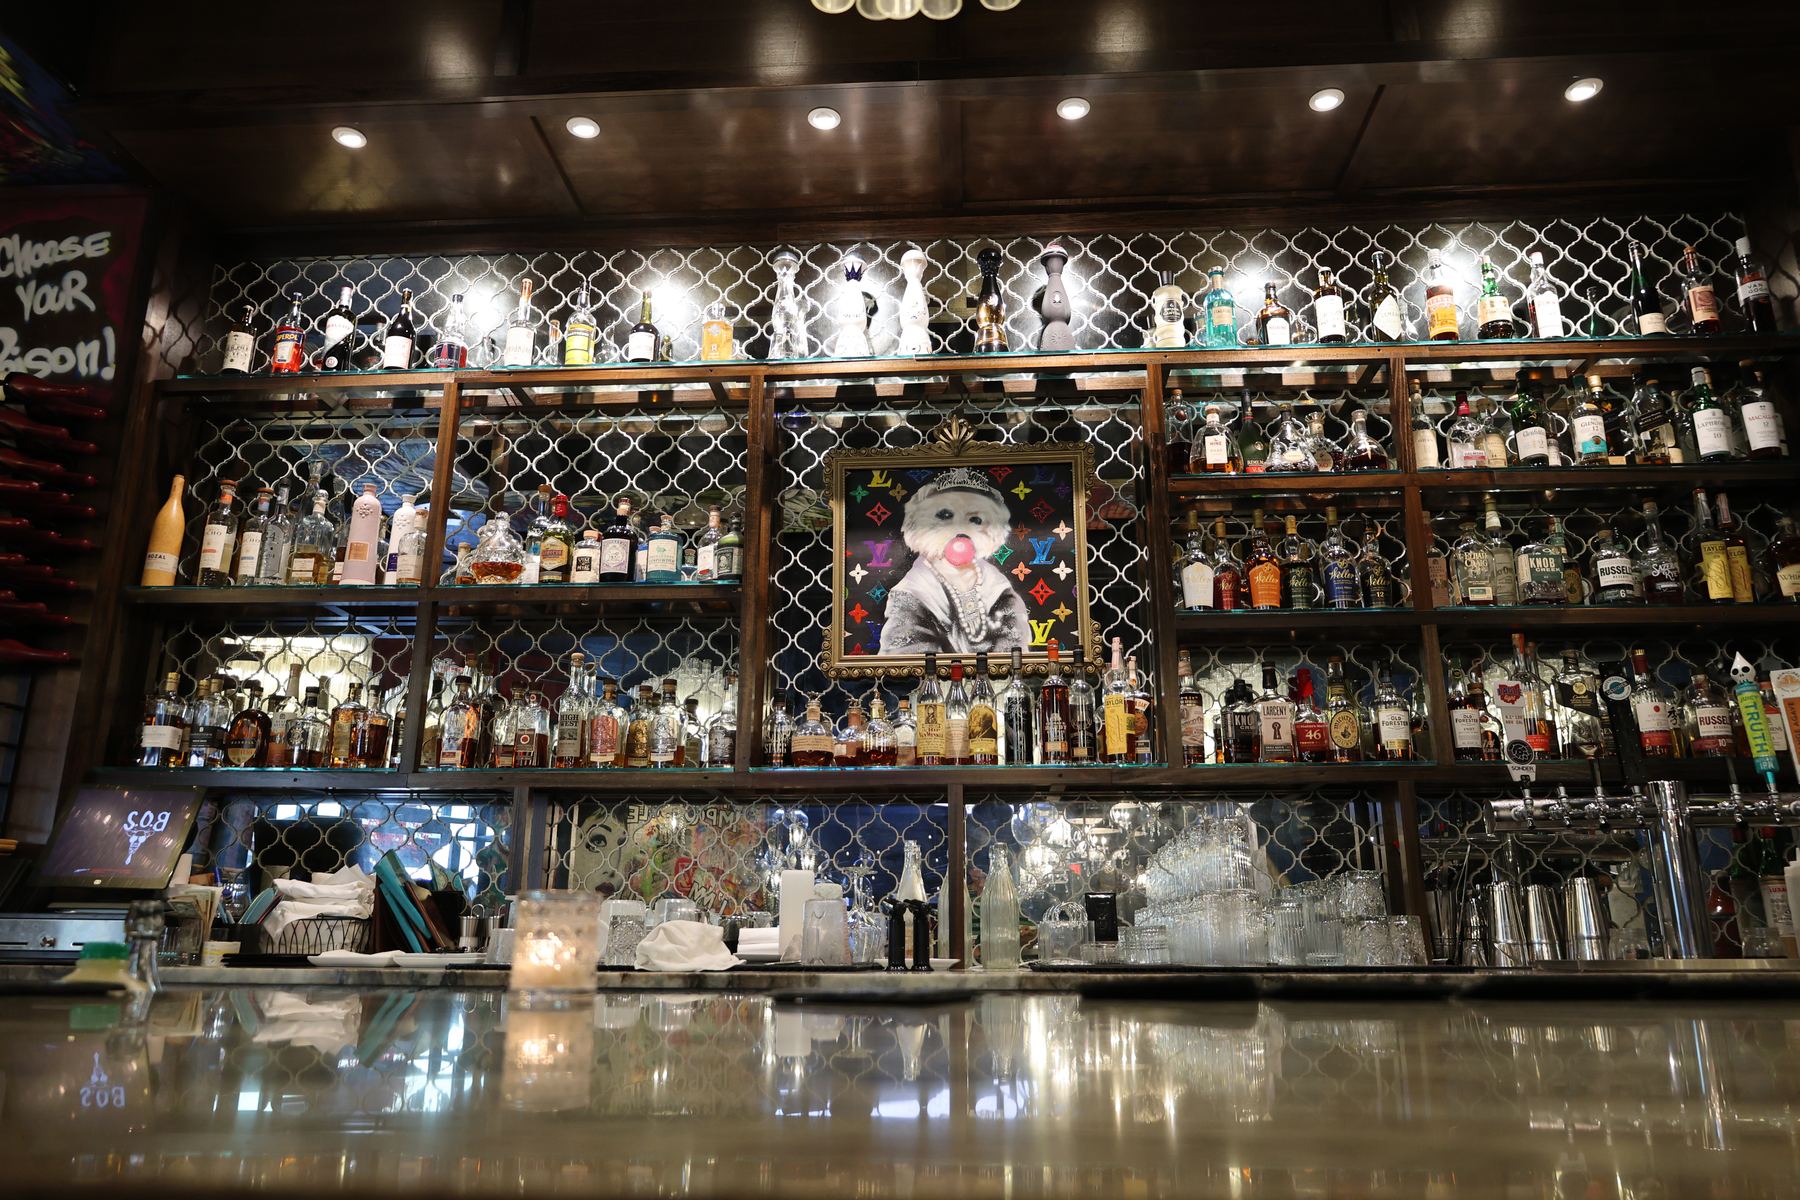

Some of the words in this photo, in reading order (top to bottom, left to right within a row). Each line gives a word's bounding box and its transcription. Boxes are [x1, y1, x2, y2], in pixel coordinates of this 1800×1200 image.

[15, 270, 96, 322] YOUR
[1697, 420, 1722, 429] LAPHRO
[1529, 557, 1556, 569] KNOB
[1254, 570, 1279, 584] Weller
[1619, 589, 1626, 598] 6
[1262, 705, 1287, 716] LARCENY
[1234, 714, 1254, 726] KNO
[1744, 701, 1769, 753] TRUTH
[1305, 729, 1322, 740] 46
[764, 743, 787, 753] STAGG
[1718, 739, 1726, 747] 10
